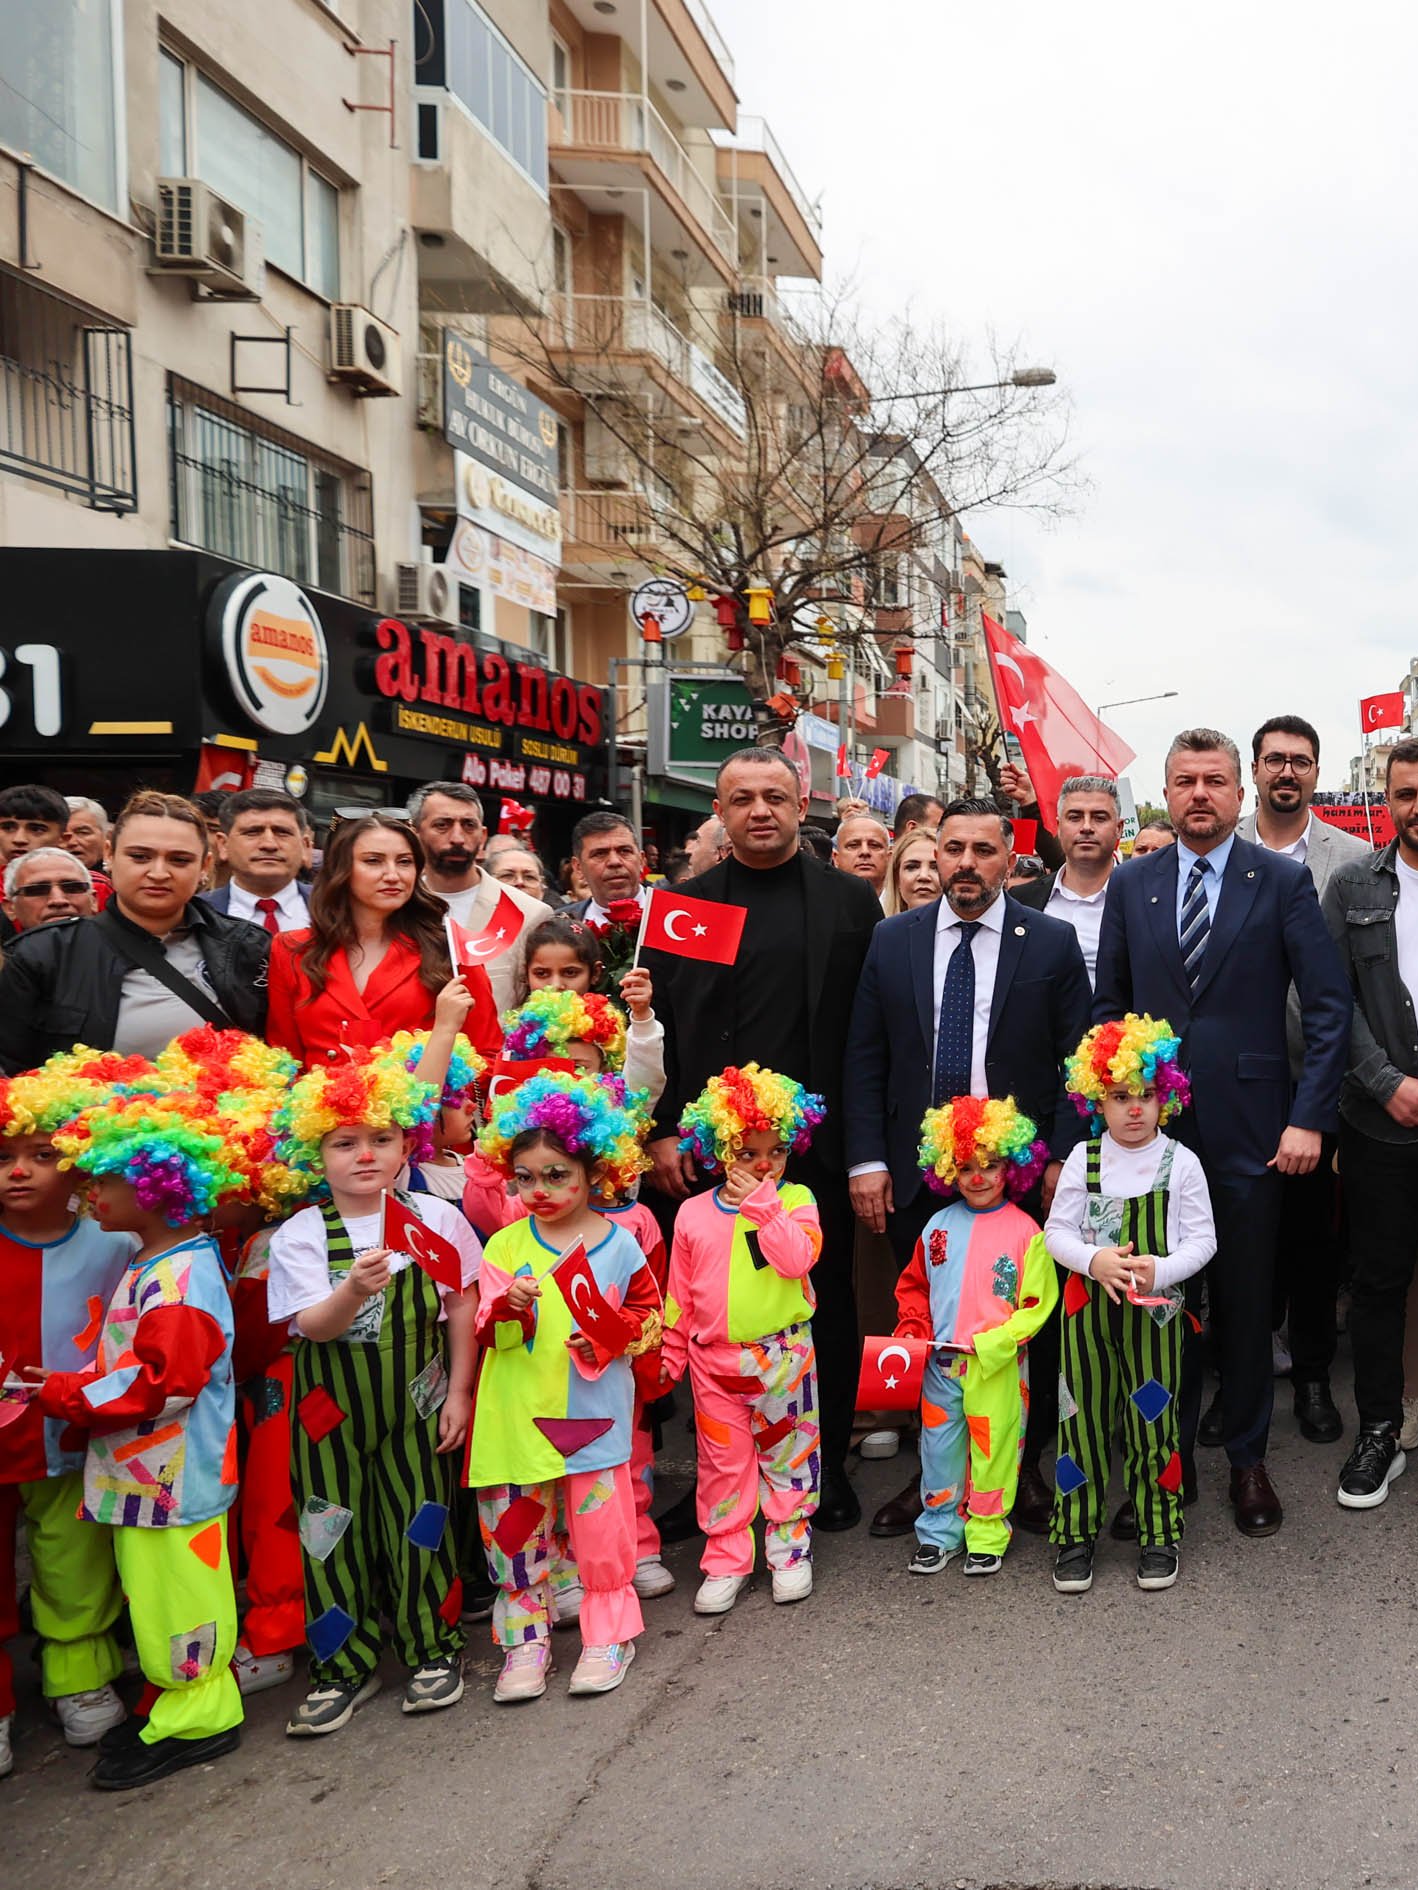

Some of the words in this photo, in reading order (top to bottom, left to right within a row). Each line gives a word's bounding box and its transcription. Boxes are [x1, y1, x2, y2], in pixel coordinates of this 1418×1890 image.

[250, 622, 315, 657] amanos
[0, 642, 62, 737] 1
[375, 618, 603, 747] amanos
[700, 722, 759, 740] SHOP
[462, 752, 487, 786] Alo
[489, 757, 526, 792] Paket
[553, 768, 570, 799] 00
